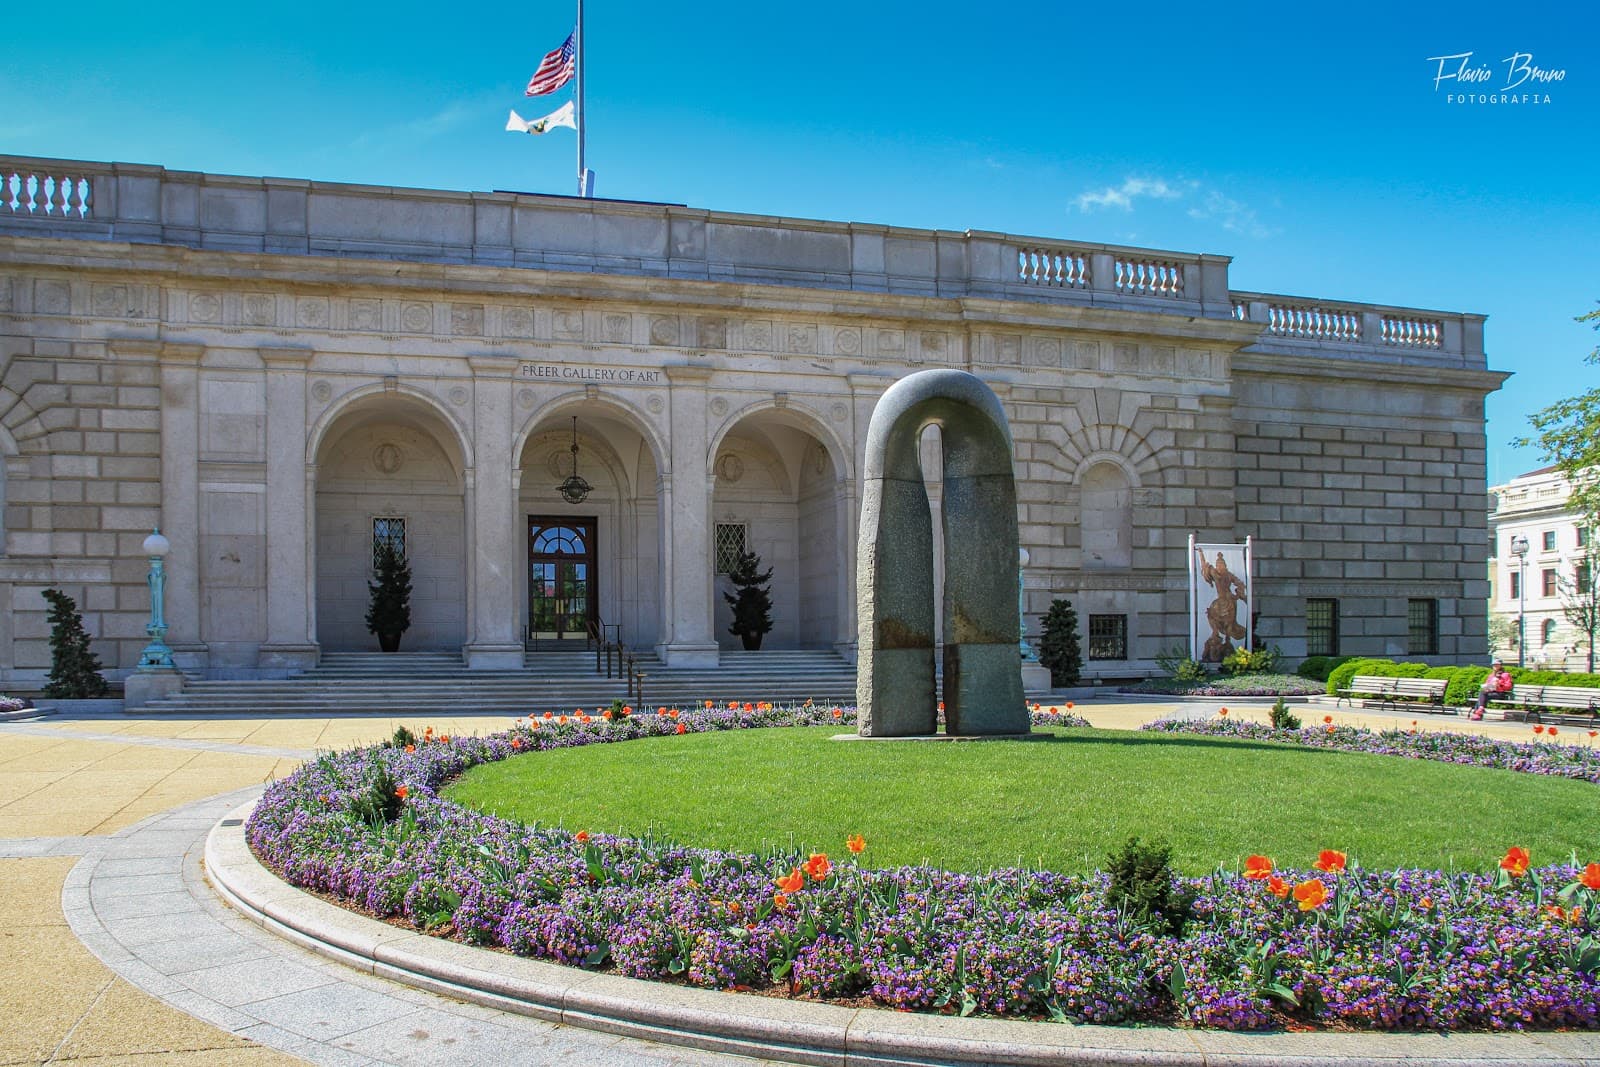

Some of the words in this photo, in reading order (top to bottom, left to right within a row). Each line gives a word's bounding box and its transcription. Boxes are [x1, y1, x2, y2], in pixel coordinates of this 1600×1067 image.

[522, 365, 560, 378] FREER
[562, 367, 616, 380] GALLERY
[619, 370, 635, 381] OF
[637, 371, 661, 382] ART
